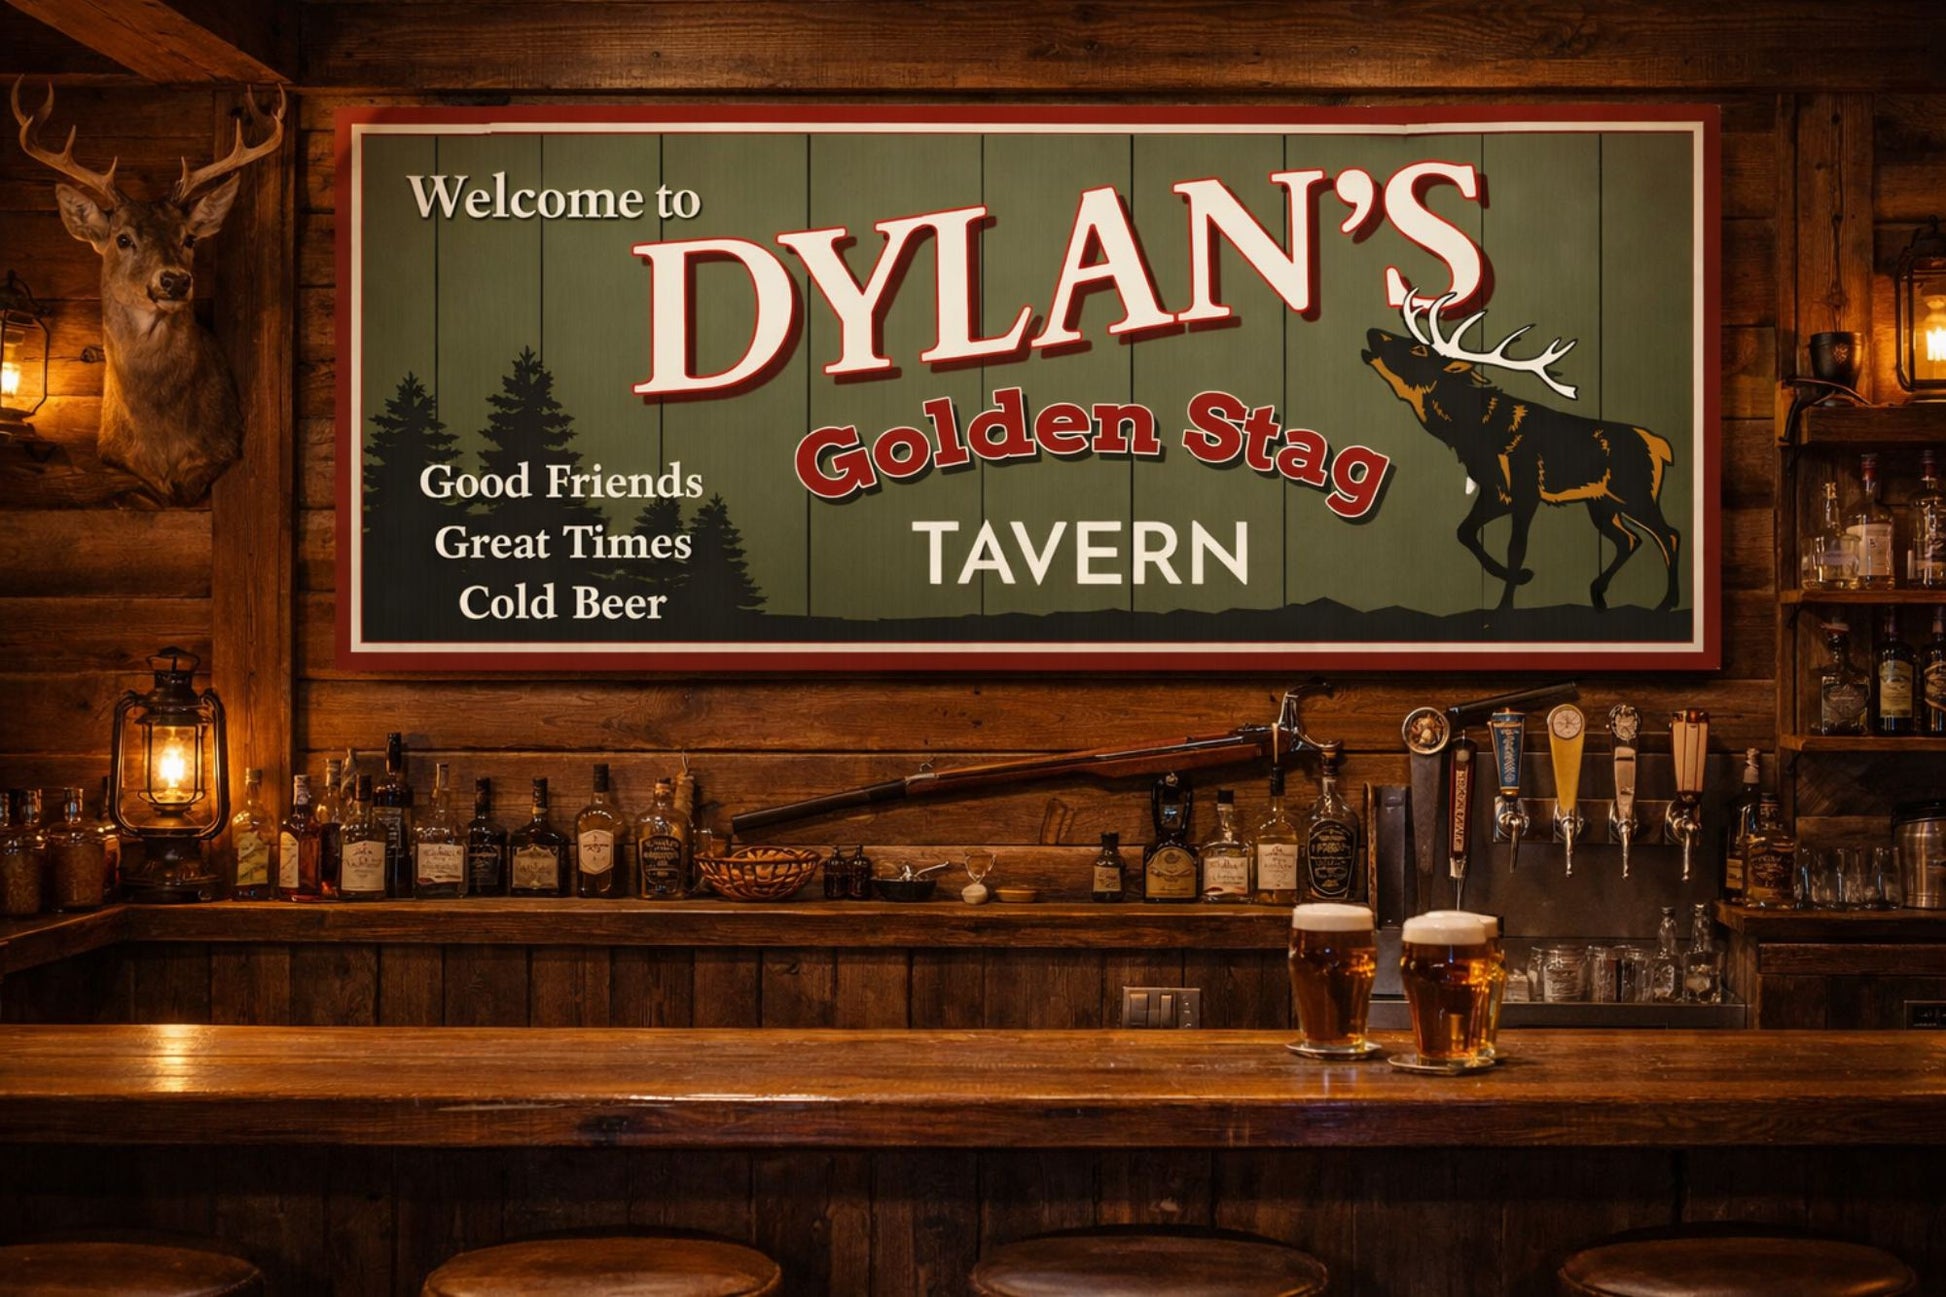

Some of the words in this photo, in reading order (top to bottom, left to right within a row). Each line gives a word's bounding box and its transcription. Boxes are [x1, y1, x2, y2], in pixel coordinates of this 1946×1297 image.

[406, 171, 645, 220] Welcome
[655, 183, 702, 220] to
[632, 159, 1490, 401] DYLAN'S
[795, 387, 1161, 499] Golden
[1182, 391, 1391, 518] Stag
[419, 461, 533, 499] Good
[545, 460, 704, 499] Friends
[434, 525, 551, 560] Great
[562, 524, 693, 560] Times
[911, 519, 1248, 586] TAVERN
[458, 582, 558, 620] Cold
[572, 585, 668, 620] Beer
